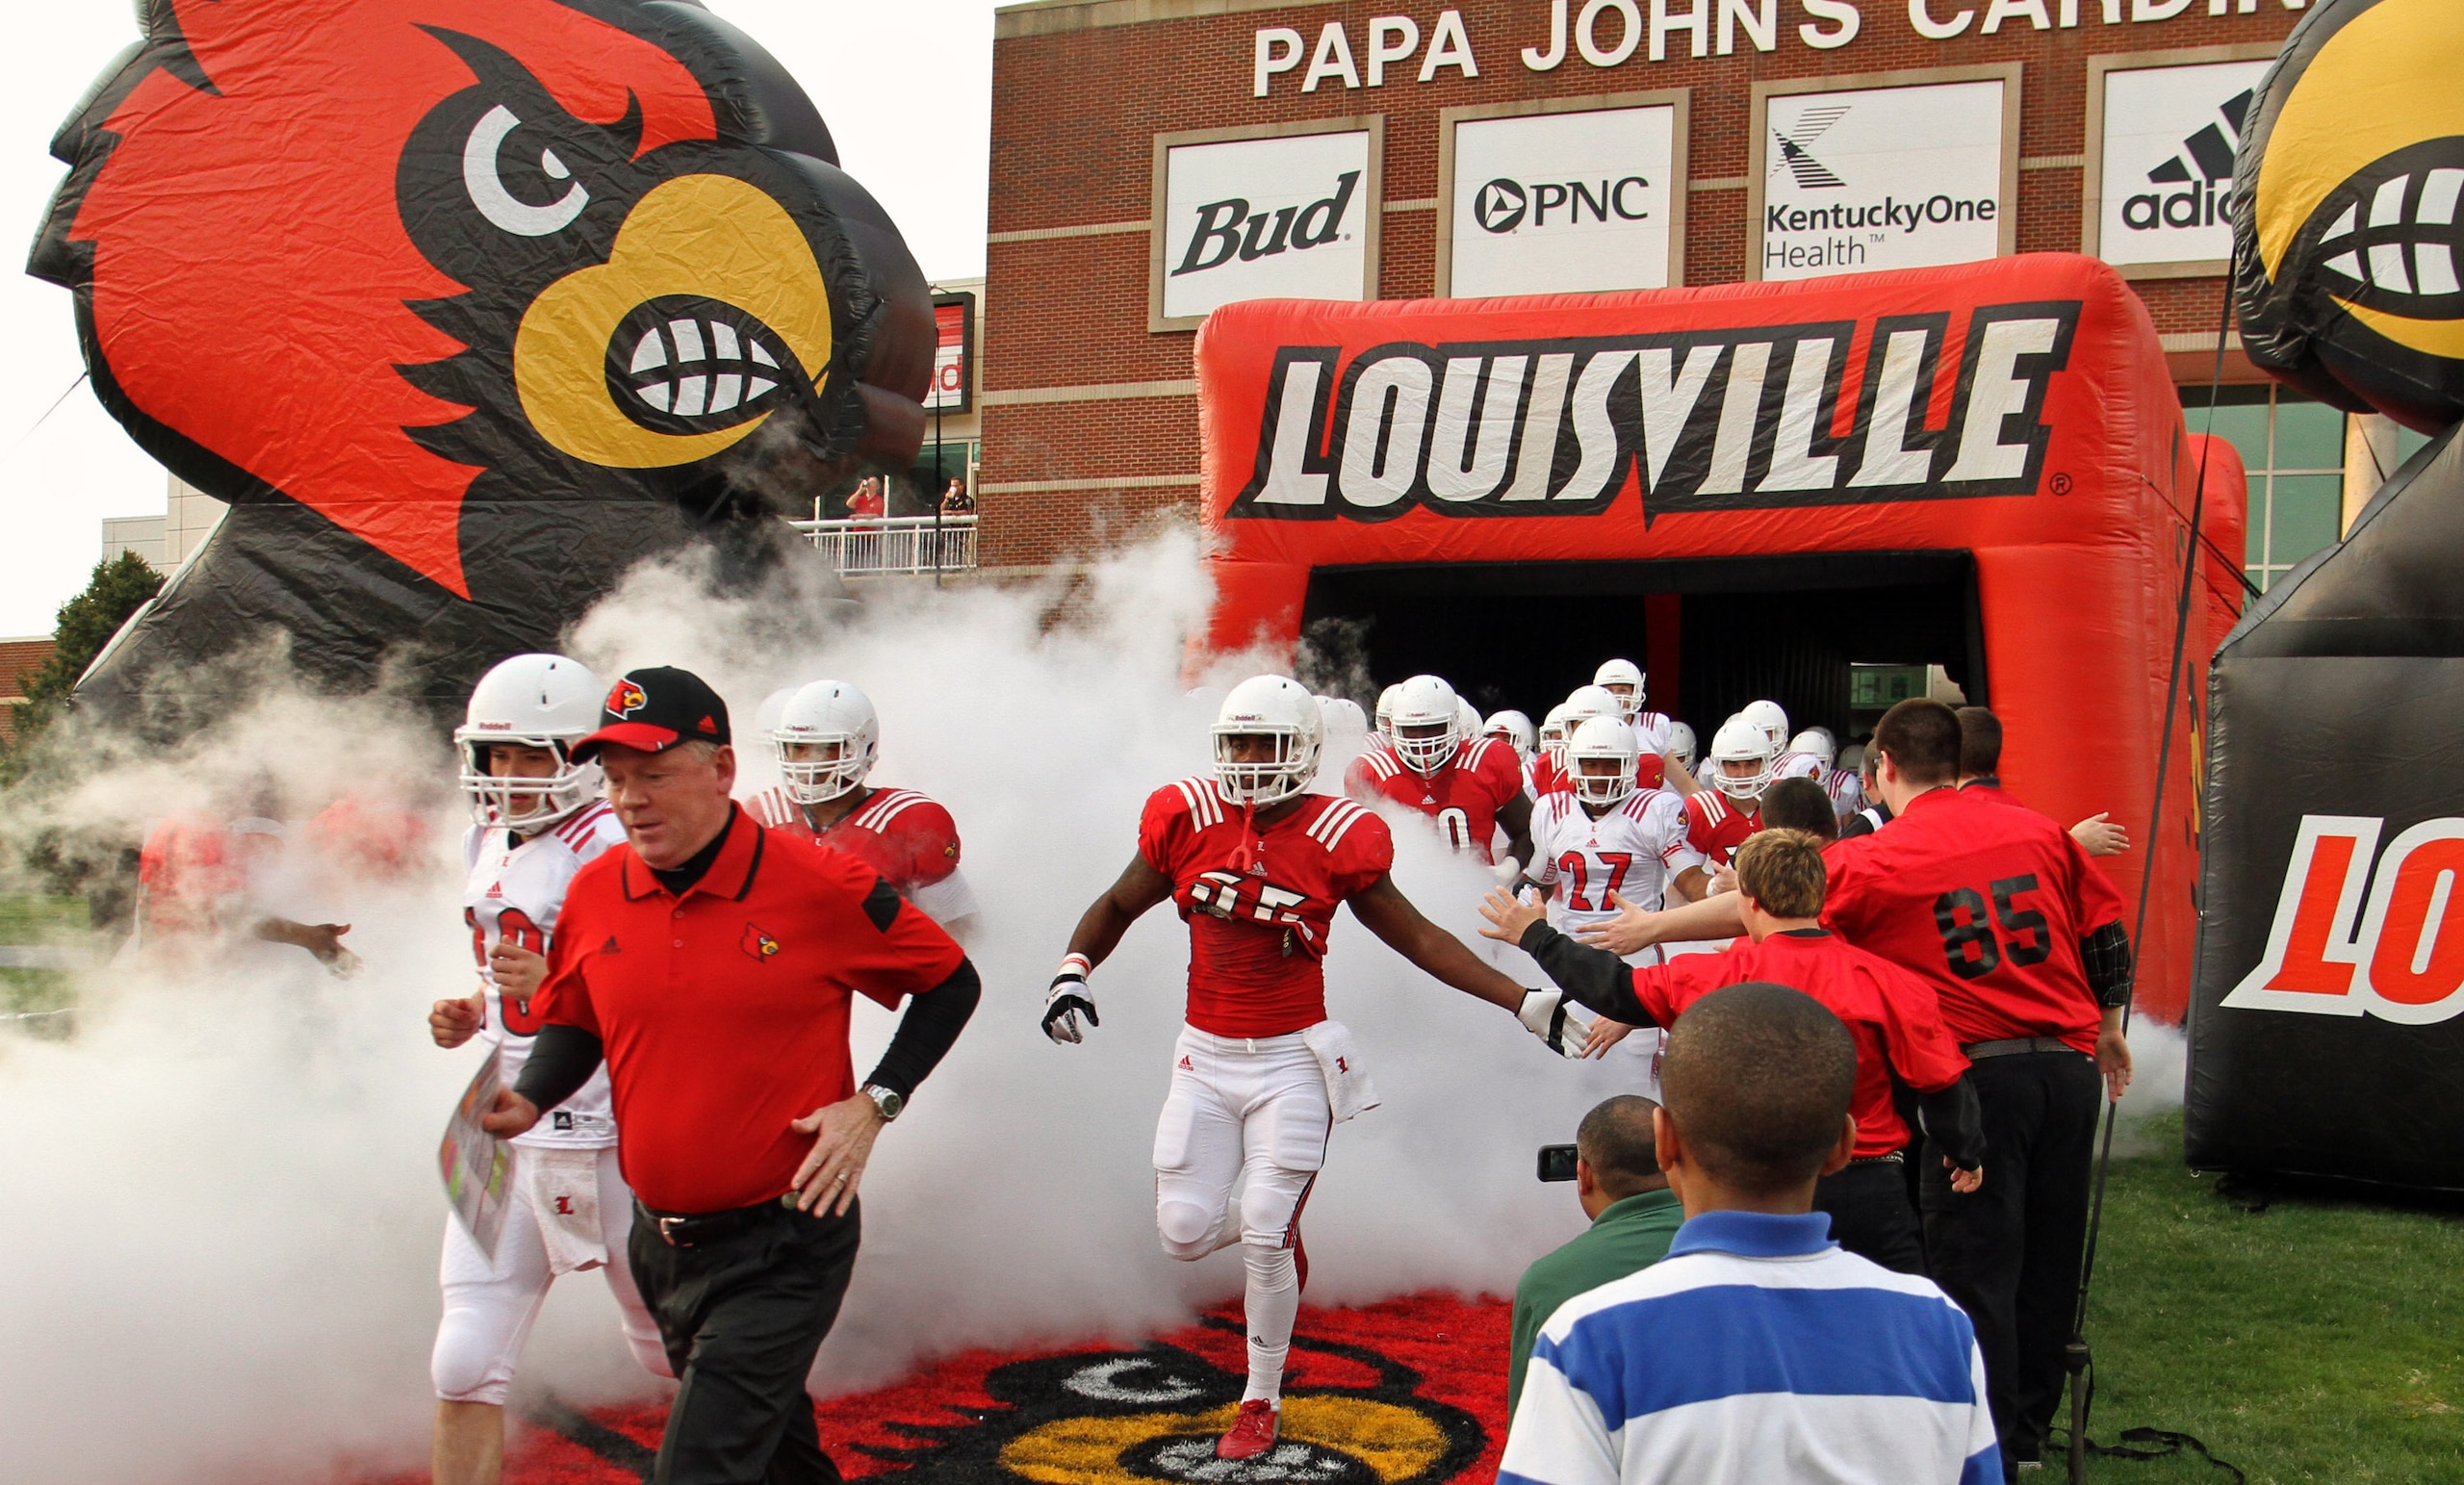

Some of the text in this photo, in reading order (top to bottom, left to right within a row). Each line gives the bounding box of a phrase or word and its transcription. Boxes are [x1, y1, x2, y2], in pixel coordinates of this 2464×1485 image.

[1253, 9, 1479, 97] PAPA
[1171, 170, 1362, 276] Bud
[1534, 177, 1649, 226] PNC
[1767, 195, 1995, 233] KentuckyOne
[1251, 316, 2062, 509] LOUISVILLE
[1558, 851, 1632, 910] 27
[1933, 874, 2052, 980] 85
